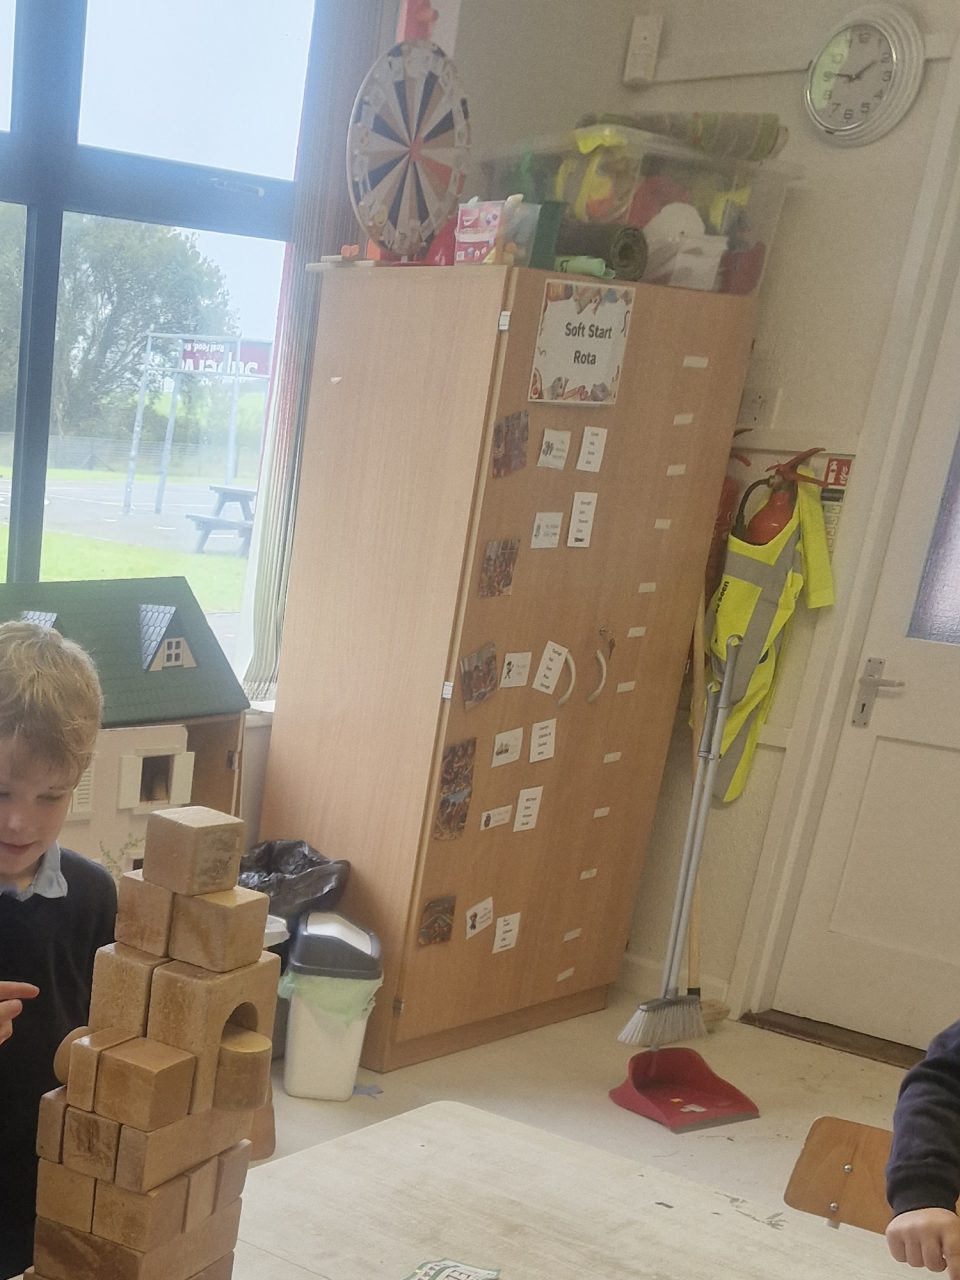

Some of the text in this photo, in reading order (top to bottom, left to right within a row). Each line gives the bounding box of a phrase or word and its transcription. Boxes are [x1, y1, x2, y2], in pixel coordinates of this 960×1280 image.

[843, 108, 854, 119] 6
[861, 102, 871, 113] 5
[564, 322, 613, 339] Soft Start
[573, 350, 597, 365] Rota
